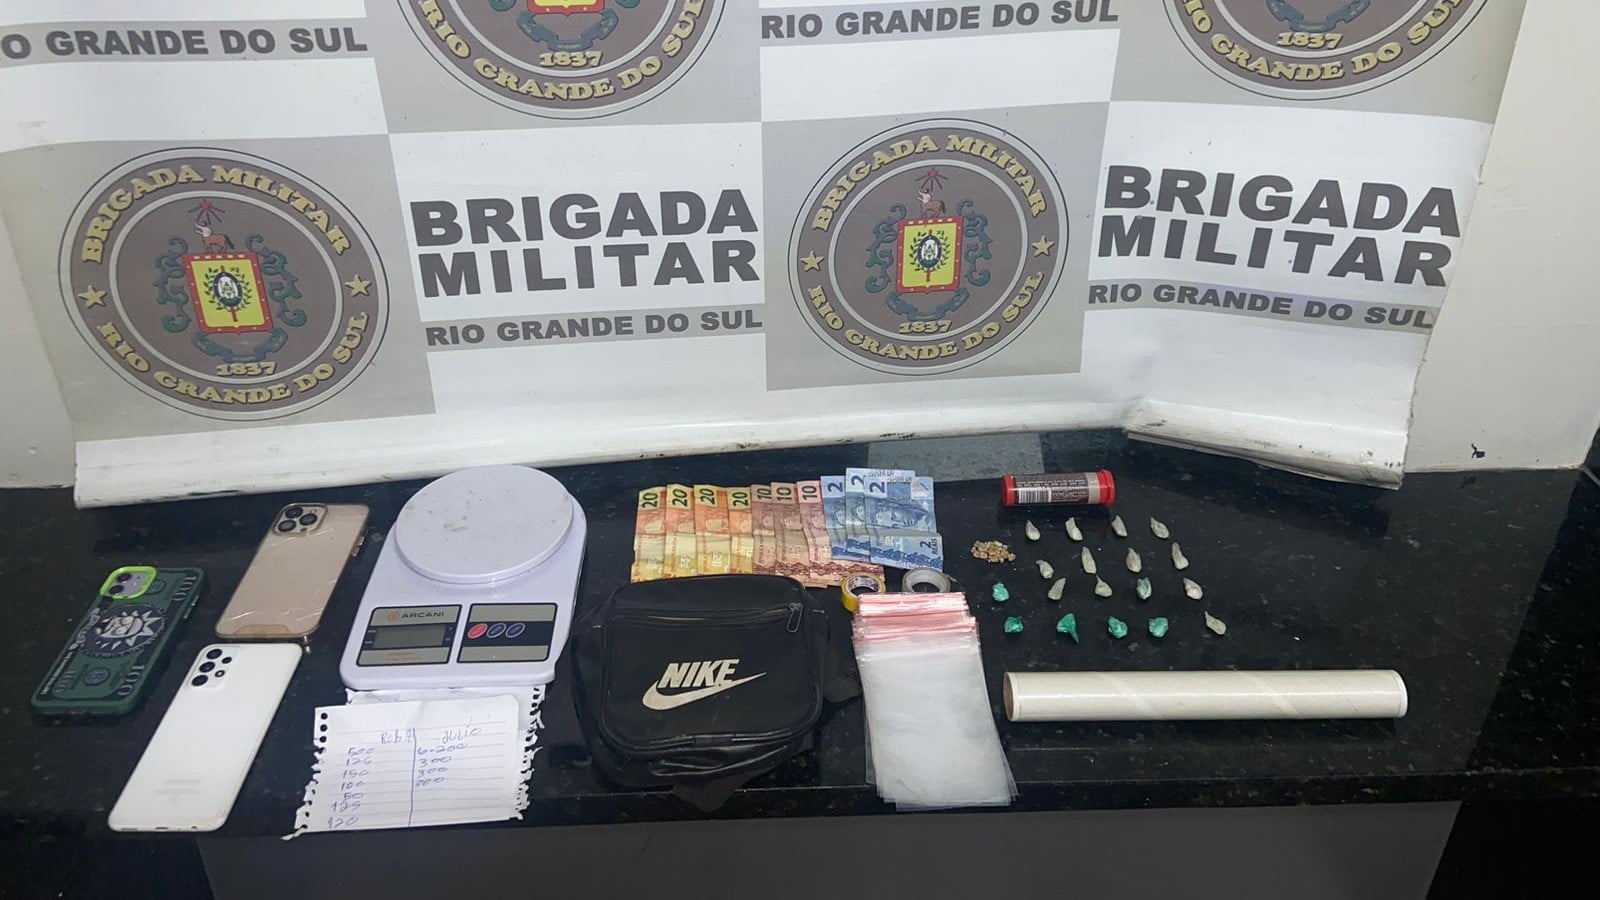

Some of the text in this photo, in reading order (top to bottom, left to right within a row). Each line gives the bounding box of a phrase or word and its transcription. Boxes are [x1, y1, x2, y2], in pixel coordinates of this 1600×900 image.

[761, 0, 1119, 39] RIO GRANDE DO SUL
[46, 30, 209, 56] GRANDE
[219, 29, 275, 55] DO
[290, 27, 368, 53] SUL
[419, 0, 470, 59] RIO
[474, 58, 615, 100] GRANDE
[621, 56, 662, 89] DO
[1183, 0, 1212, 33] IO
[1211, 33, 1345, 81] GRANDE
[1351, 42, 1403, 74] DO
[1277, 32, 1344, 49] 1837
[539, 51, 603, 67] 1837
[811, 134, 1047, 232] BRIGADA MILITAR
[1104, 165, 1461, 238] BRIGADA
[81, 164, 351, 265] BRIGADA MILITAR
[410, 189, 758, 247] BRIGADA
[1098, 215, 1451, 287] MILITAR
[418, 239, 760, 297] MILITAR
[807, 271, 1044, 361] RIO GRANDE DO SUL
[1088, 283, 1433, 329] RIO GRANDE DO SUL
[425, 309, 763, 347] RIO GRANDE DO SUL
[899, 318, 953, 334] 1837
[97, 311, 370, 405] RIO GRANDE DO SUL
[215, 360, 277, 377] 1837
[801, 485, 818, 500] 10
[827, 482, 844, 493] 2
[851, 475, 864, 486] 2
[869, 482, 885, 493] 2
[642, 492, 658, 508] 20
[672, 488, 688, 507] 20
[699, 488, 715, 505] 20
[732, 491, 749, 507] 20
[757, 487, 772, 500] 10
[776, 487, 792, 502] 10
[401, 611, 445, 619] ARCANI
[657, 659, 739, 688] NIKE
